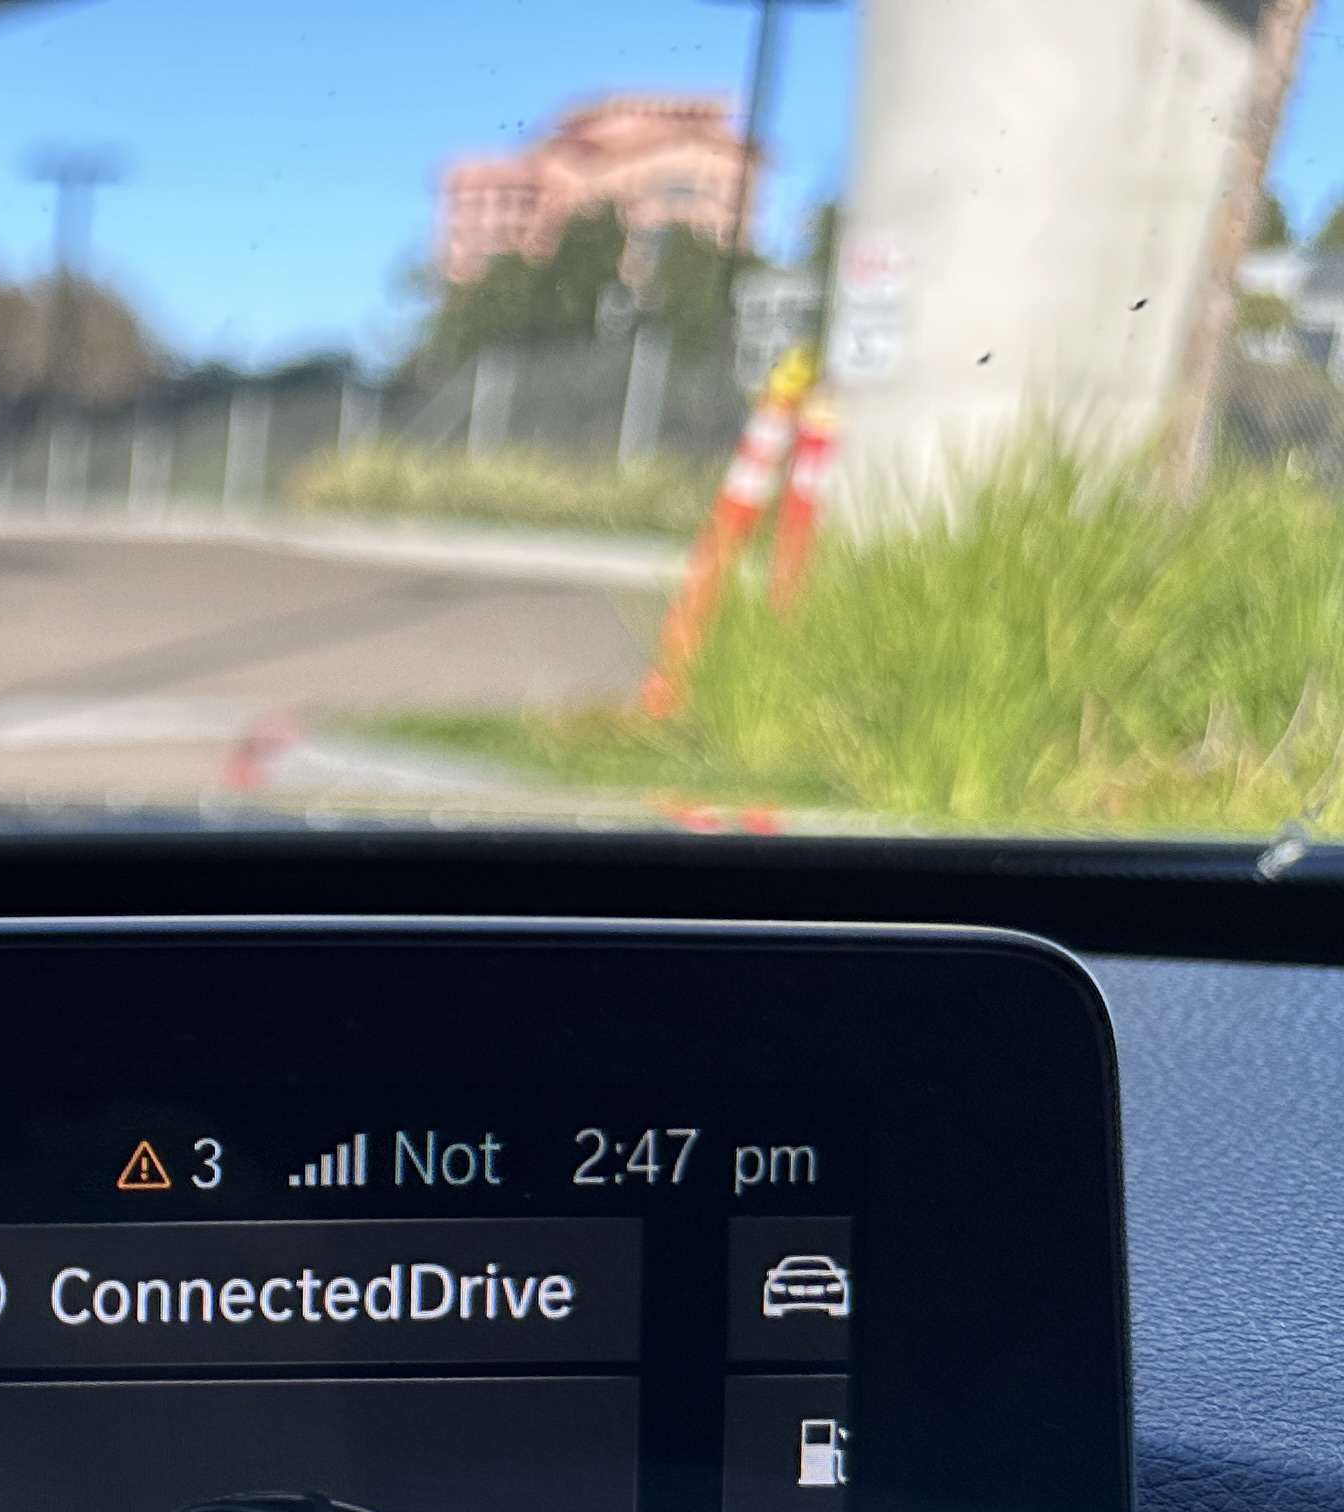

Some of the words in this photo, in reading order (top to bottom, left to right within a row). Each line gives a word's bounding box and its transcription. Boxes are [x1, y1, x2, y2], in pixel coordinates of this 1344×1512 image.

[191, 1137, 223, 1189] 3
[394, 1130, 503, 1186] Not
[572, 1127, 700, 1184] 2:47
[734, 1140, 816, 1194] pm
[50, 1262, 575, 1326] ConnectedDrive
